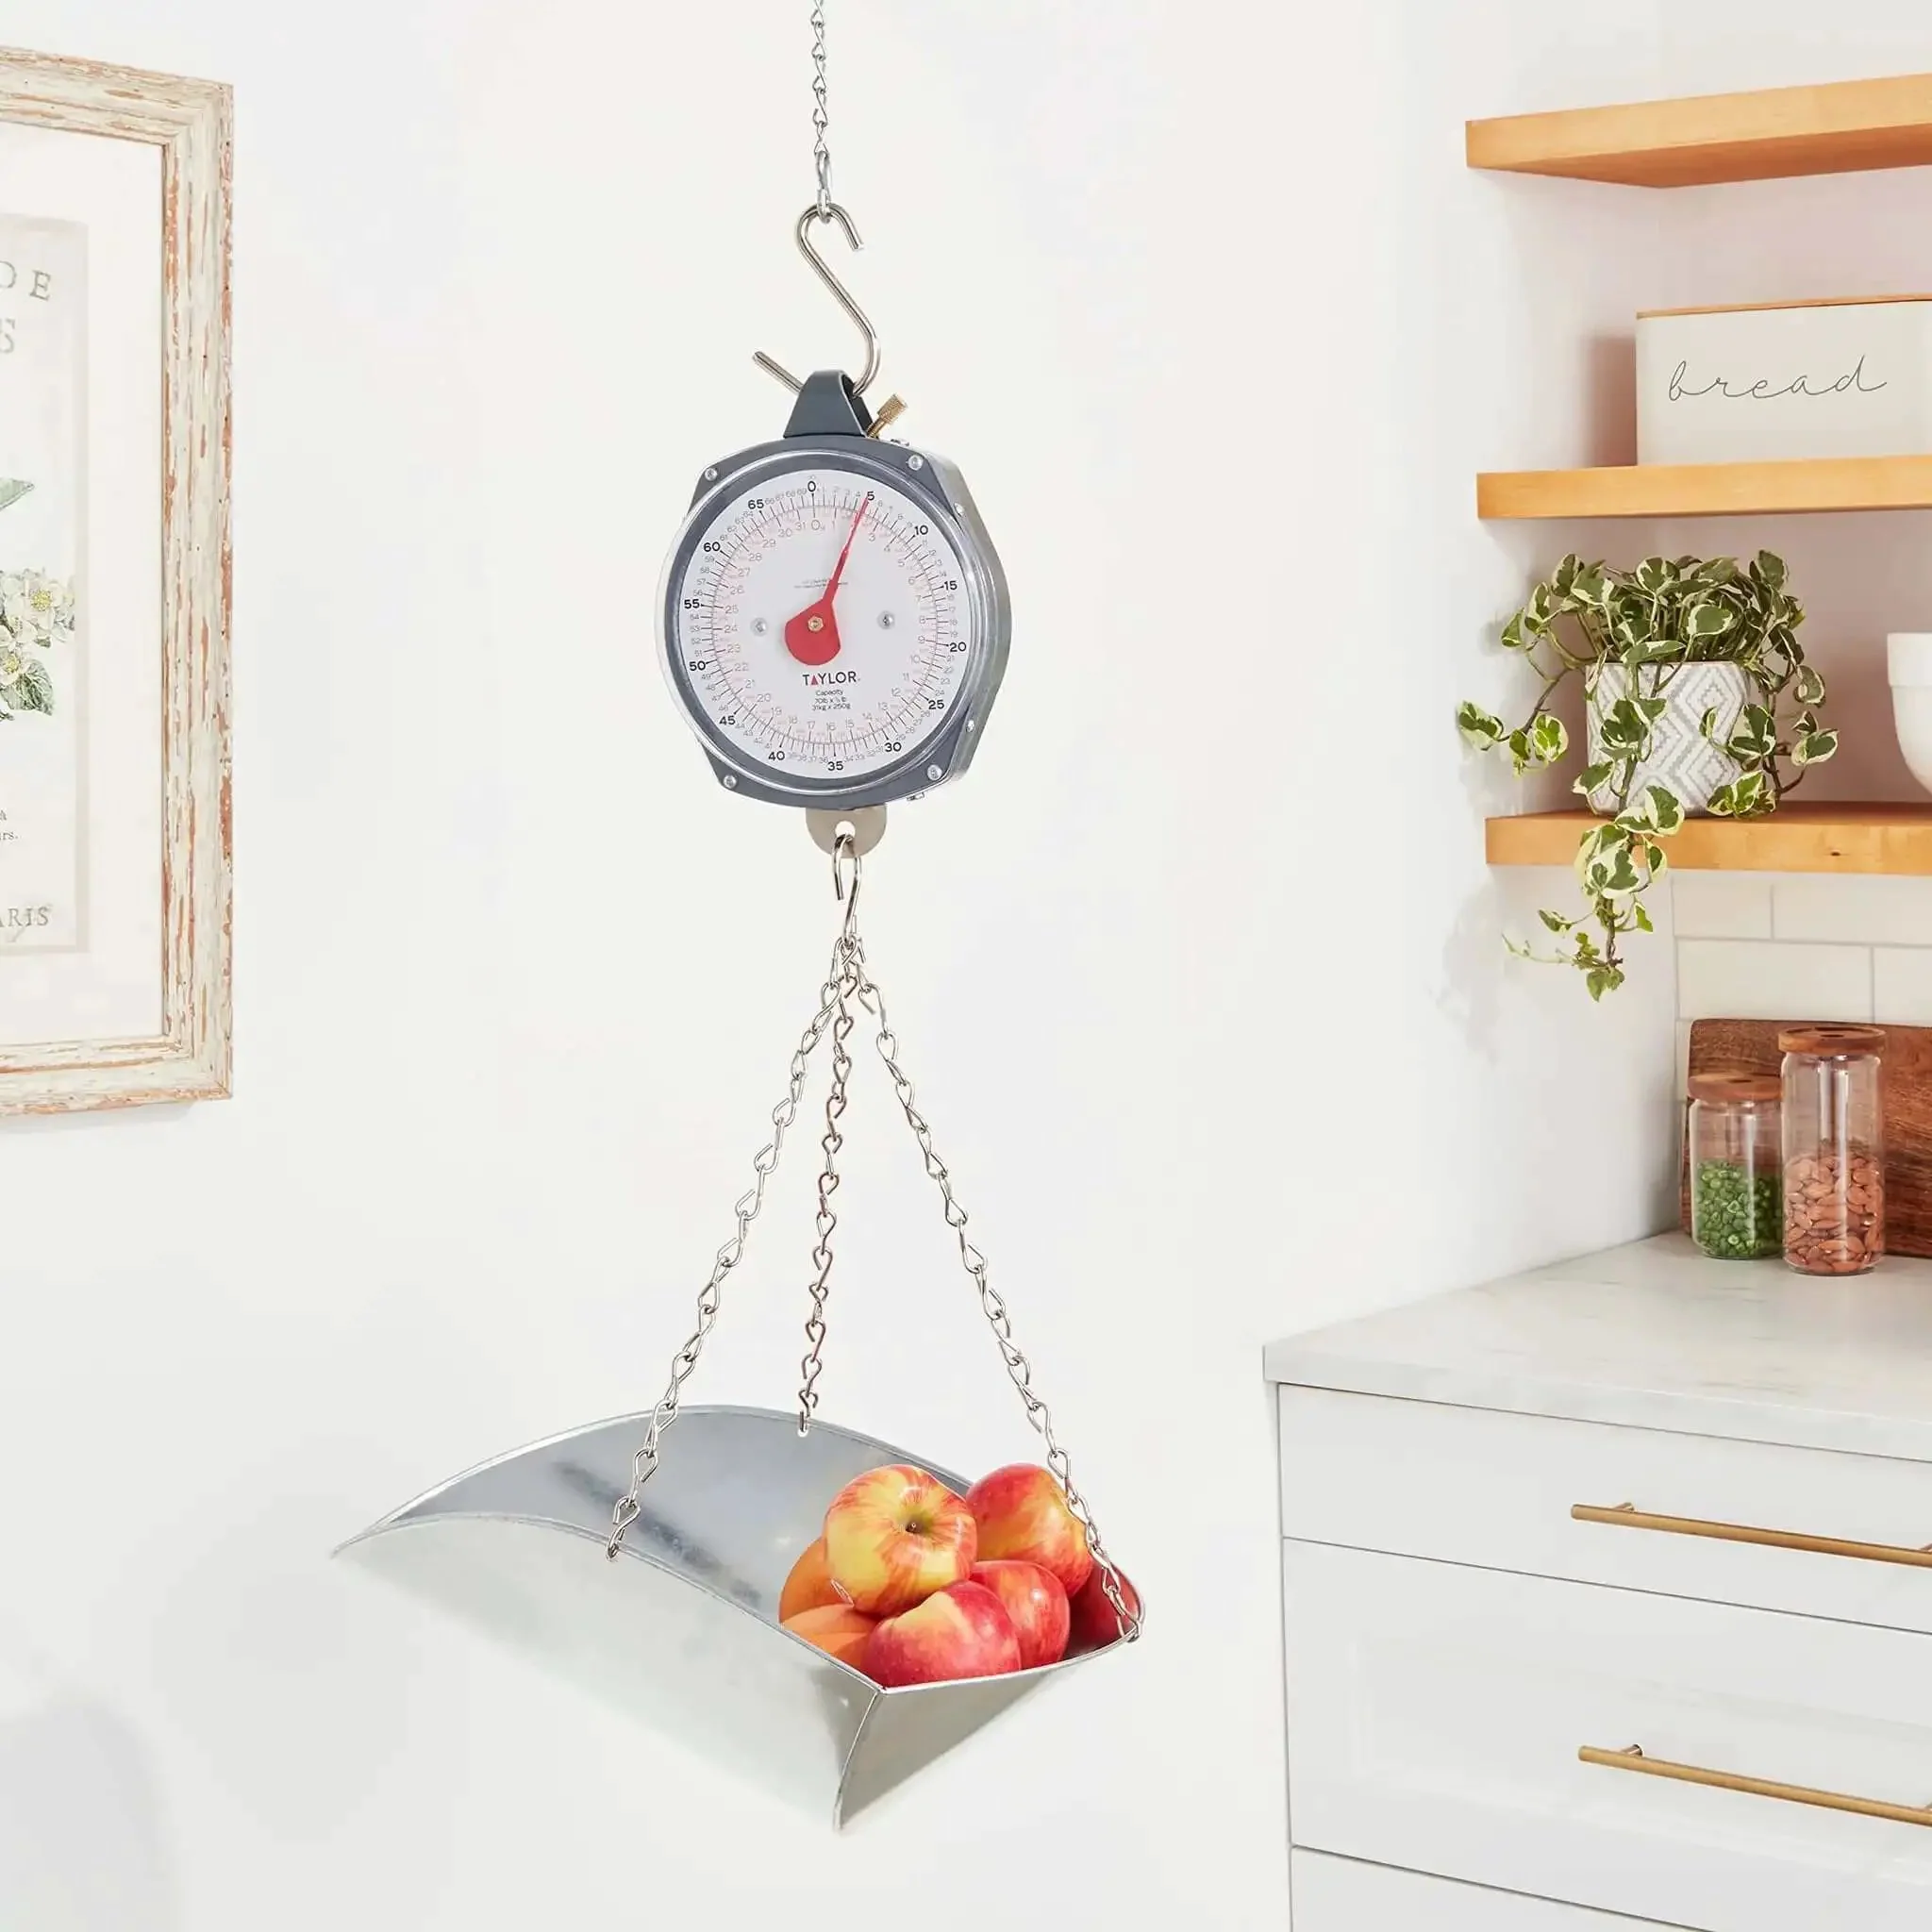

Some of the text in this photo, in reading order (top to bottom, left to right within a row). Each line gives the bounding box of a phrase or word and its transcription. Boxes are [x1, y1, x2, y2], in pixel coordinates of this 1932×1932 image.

[1669, 354, 1887, 402] bread
[808, 481, 816, 491] 0
[867, 491, 875, 501] 5
[747, 499, 764, 509] 65
[810, 519, 821, 530] 0
[777, 527, 792, 538] 30
[914, 525, 928, 536] 10
[868, 532, 876, 541] 3
[703, 541, 720, 552] 60
[761, 539, 776, 549] 29
[748, 552, 762, 562] 28
[737, 566, 751, 577] 27
[944, 581, 958, 591] 15
[684, 599, 700, 609] 55
[949, 641, 967, 652] 20
[690, 660, 706, 671] 50
[802, 671, 857, 686] TAYLOR
[756, 693, 771, 703] 20
[928, 699, 945, 709] 25
[719, 715, 736, 725] 45
[884, 741, 902, 752] 30
[768, 751, 785, 760] 40
[827, 760, 843, 771] 35
